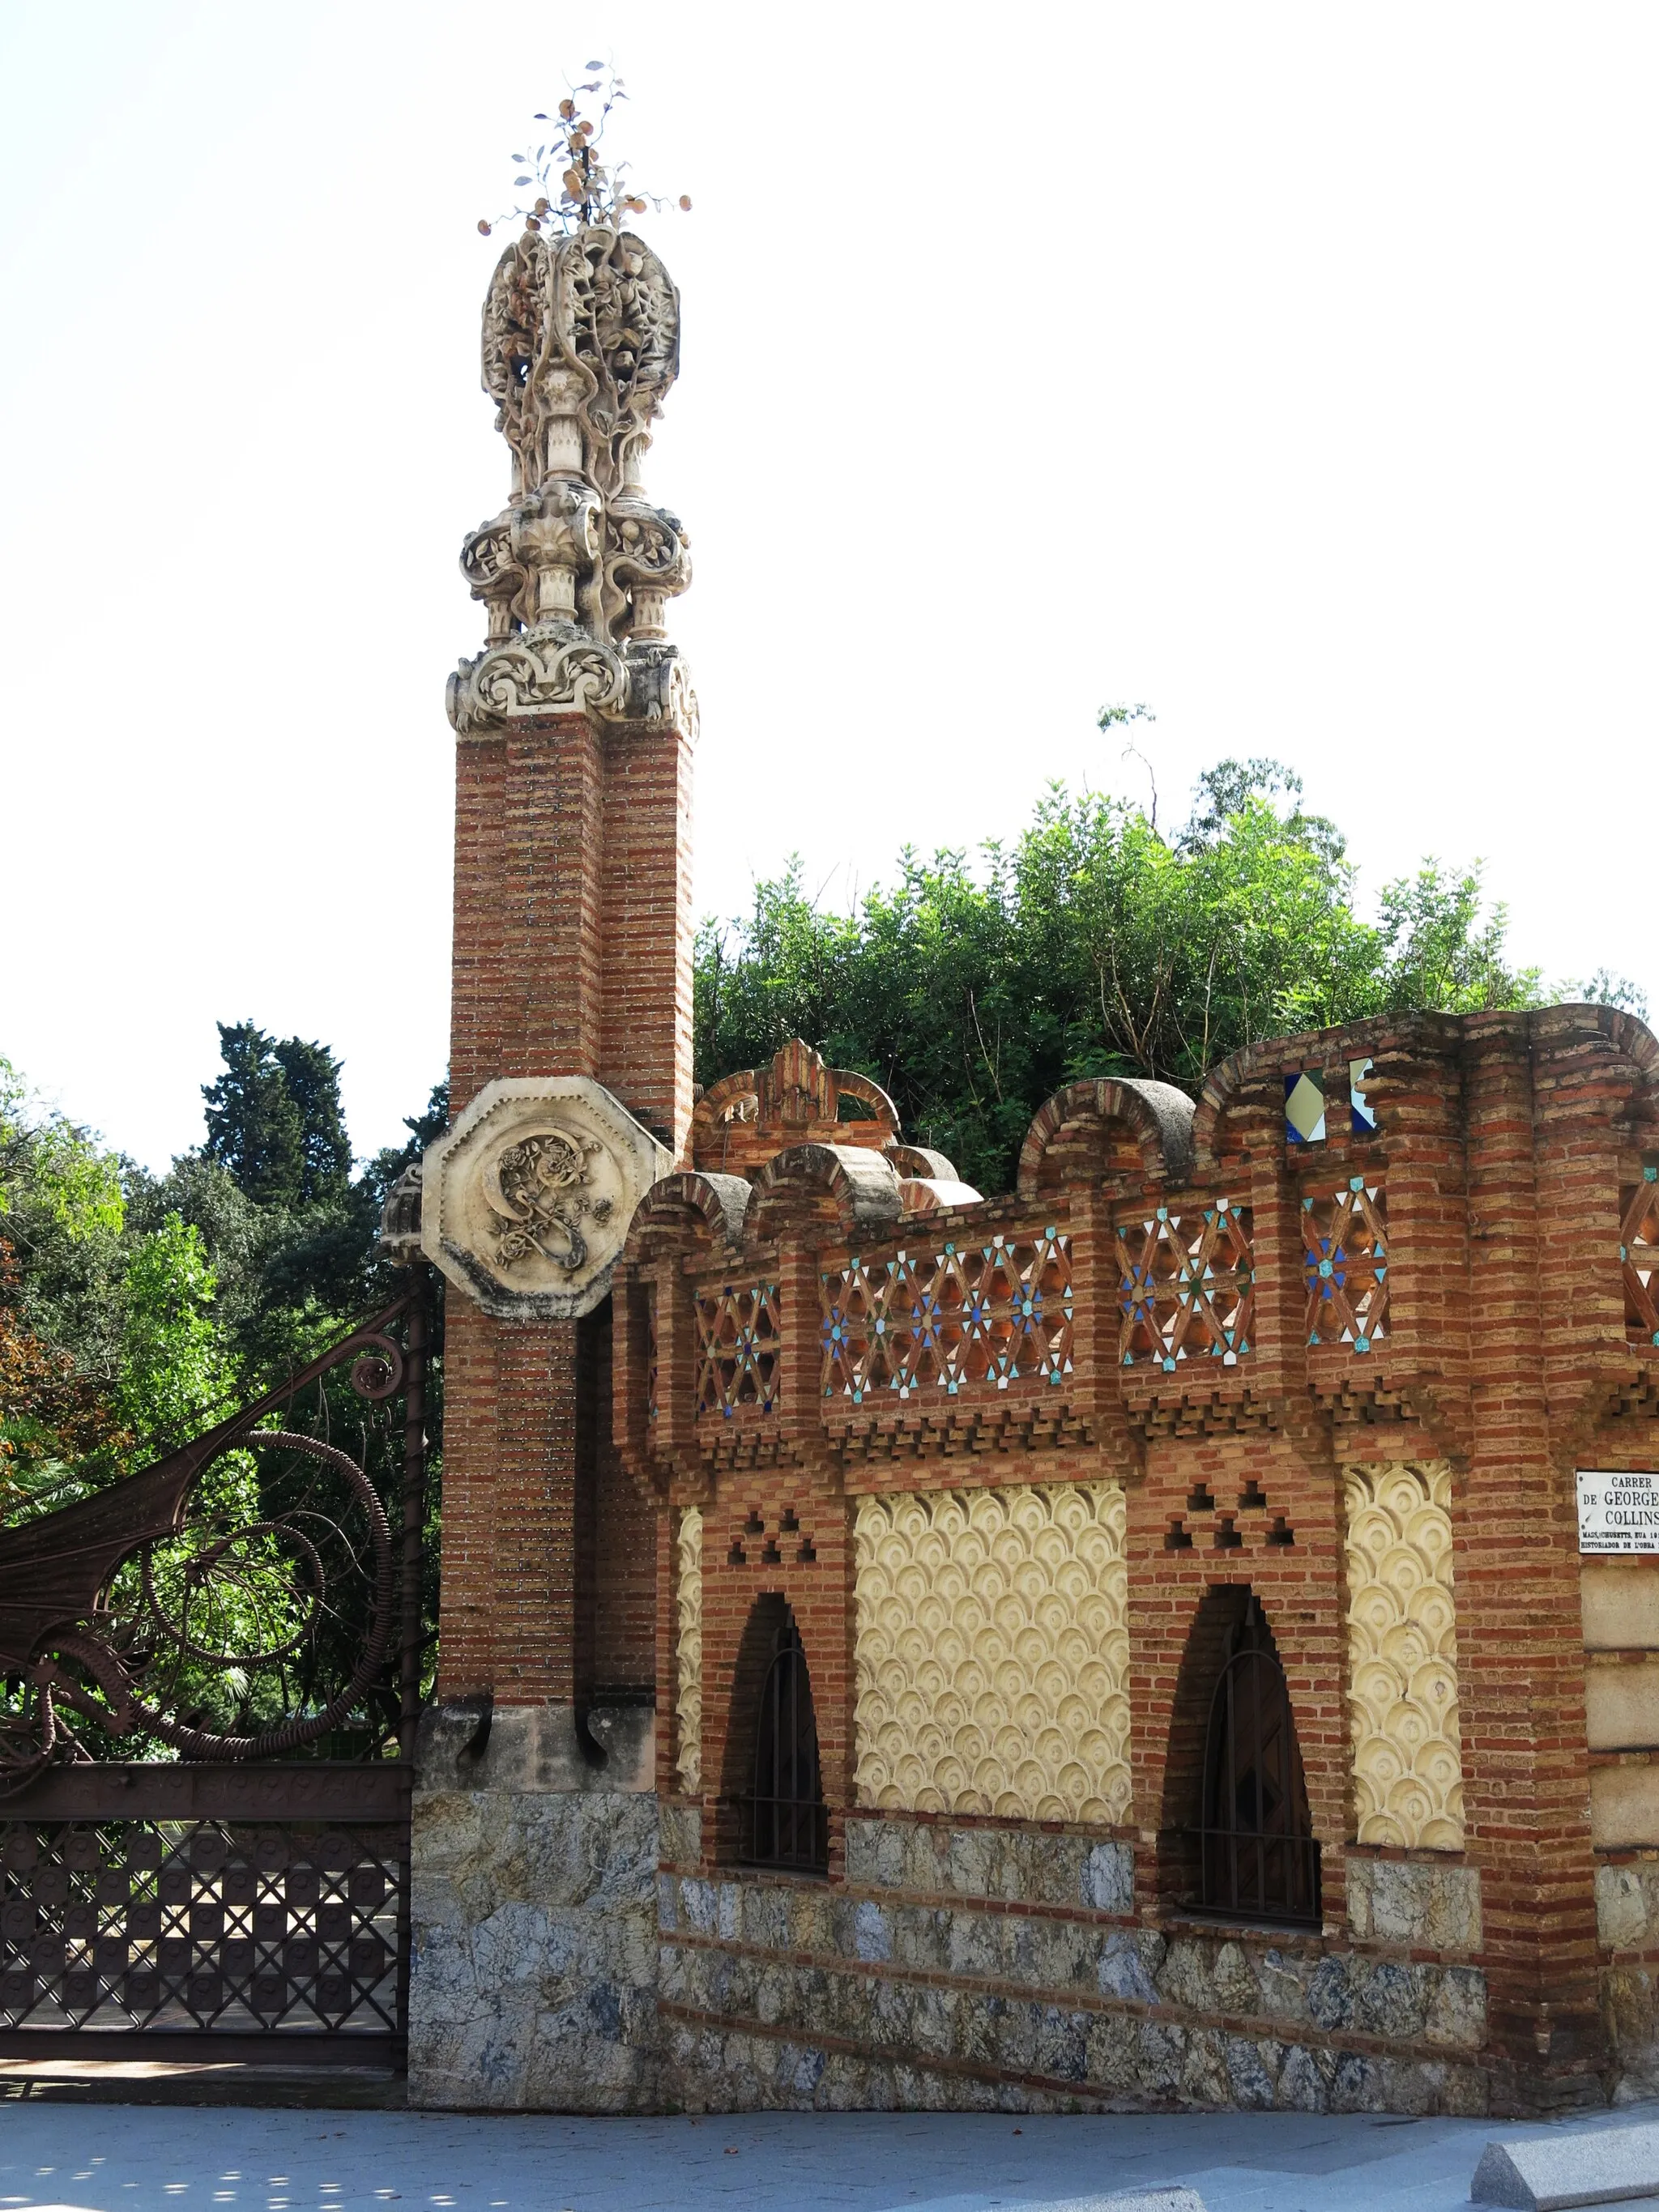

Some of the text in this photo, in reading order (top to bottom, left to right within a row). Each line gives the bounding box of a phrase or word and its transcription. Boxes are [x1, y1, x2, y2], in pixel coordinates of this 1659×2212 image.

[1611, 1477, 1652, 1488] CARRER
[1584, 1491, 1659, 1506] DE GEORGE
[1606, 1510, 1659, 1525] COLLINS
